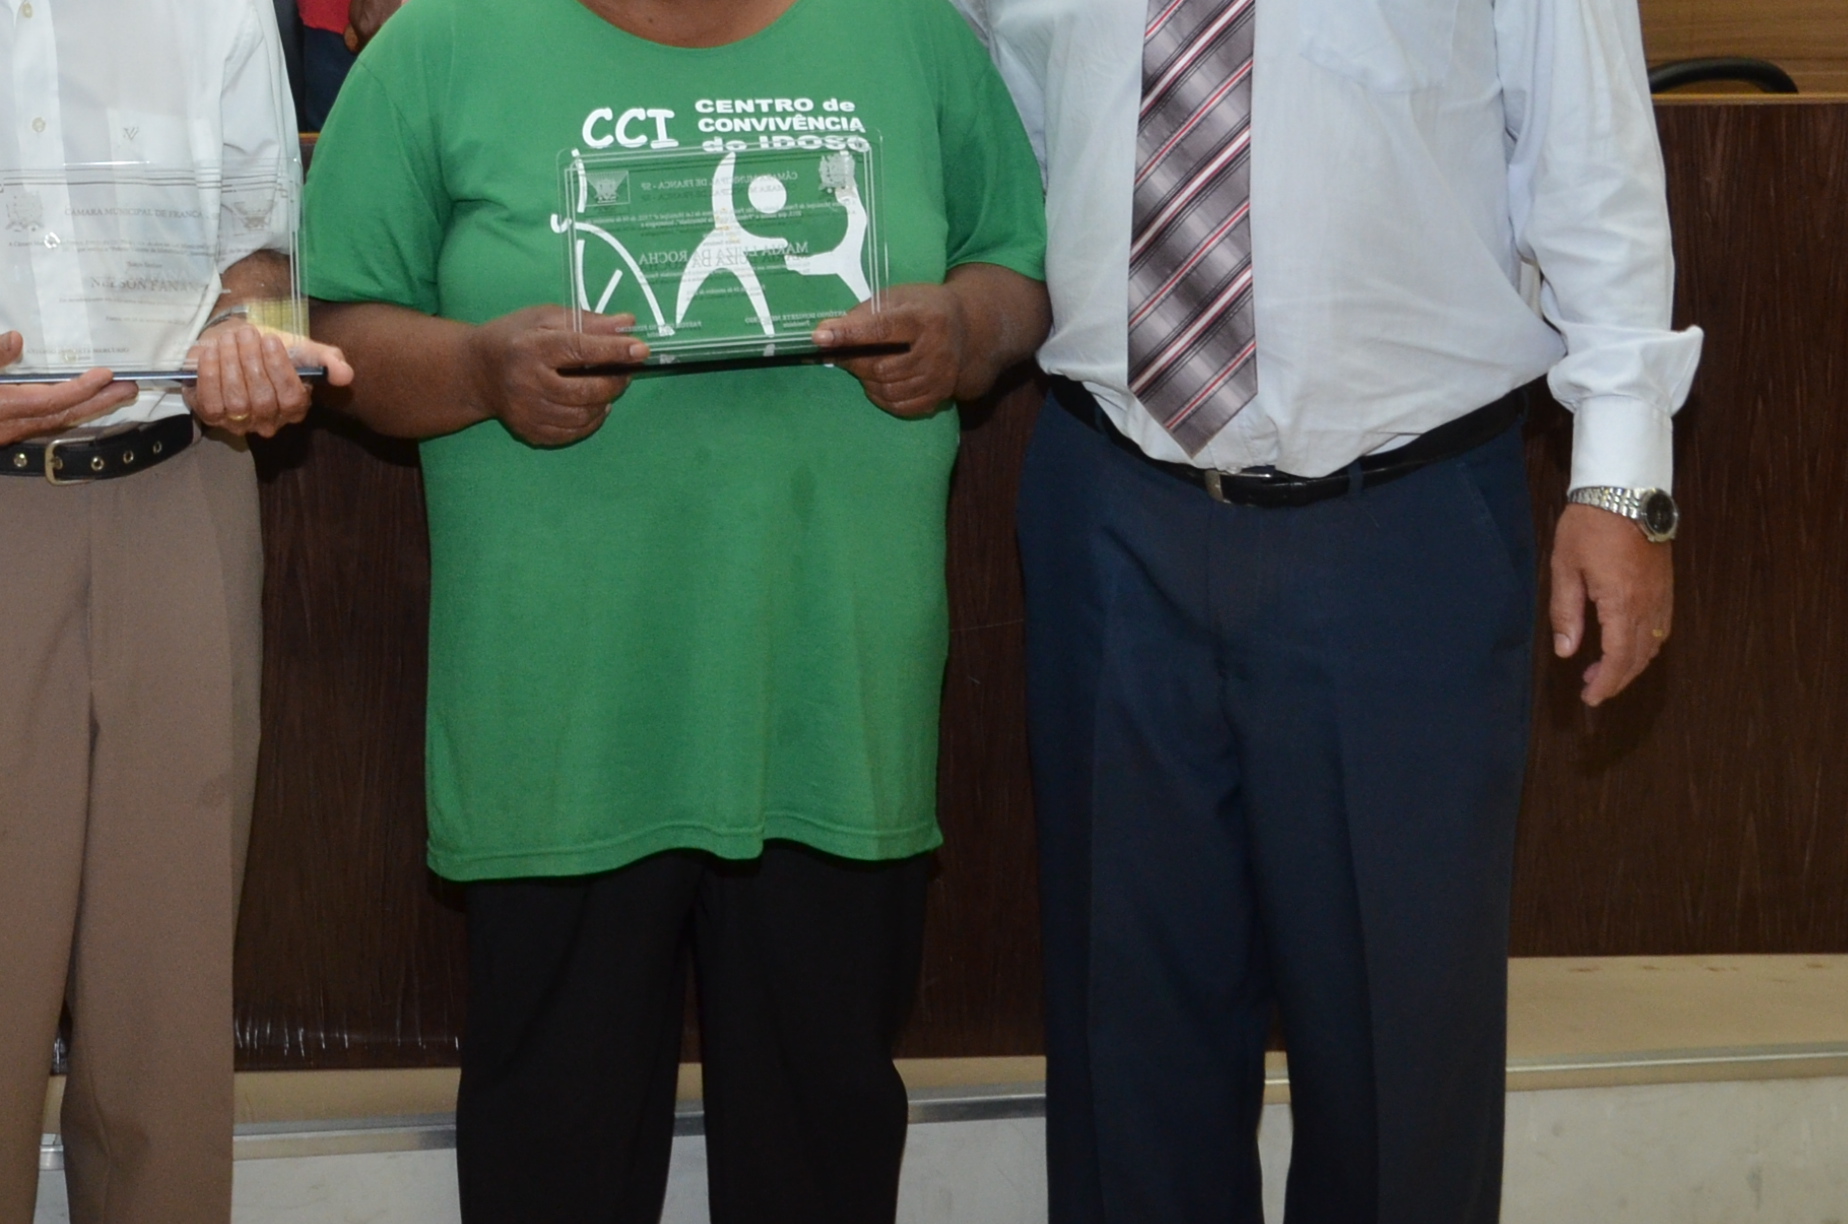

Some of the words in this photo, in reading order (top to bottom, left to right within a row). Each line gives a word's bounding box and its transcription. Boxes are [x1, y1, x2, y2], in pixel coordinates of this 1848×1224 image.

[695, 98, 814, 114] CENTRO
[822, 98, 856, 113] de
[582, 107, 679, 149] CCI
[698, 114, 866, 133] CONVIVÊNCIA
[702, 136, 747, 153] do
[759, 135, 870, 153] IDOSO
